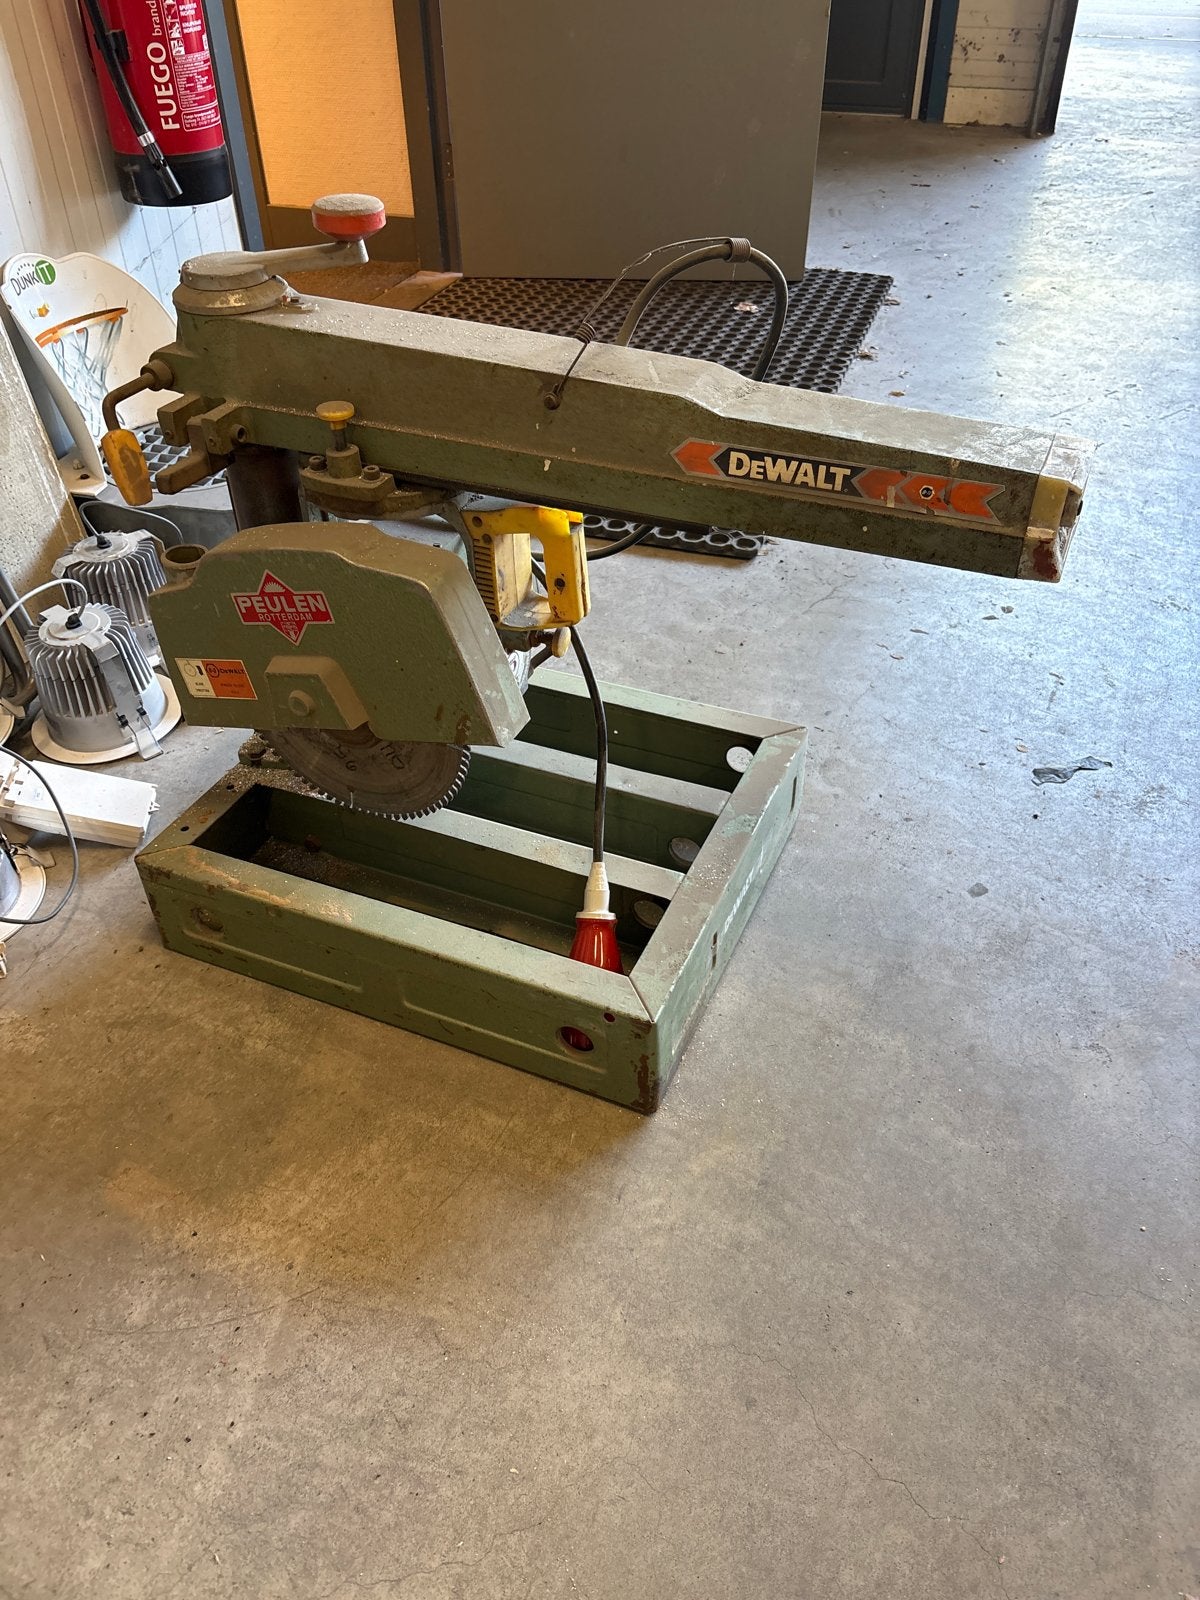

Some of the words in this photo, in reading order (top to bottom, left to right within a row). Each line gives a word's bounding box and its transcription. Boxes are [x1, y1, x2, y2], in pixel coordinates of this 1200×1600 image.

[146, 42, 180, 130] FUEGO
[10, 271, 40, 296] DUNK
[36, 263, 52, 284] IT
[236, 595, 326, 613] PEULEN
[259, 613, 313, 621] ROTTERDAM
